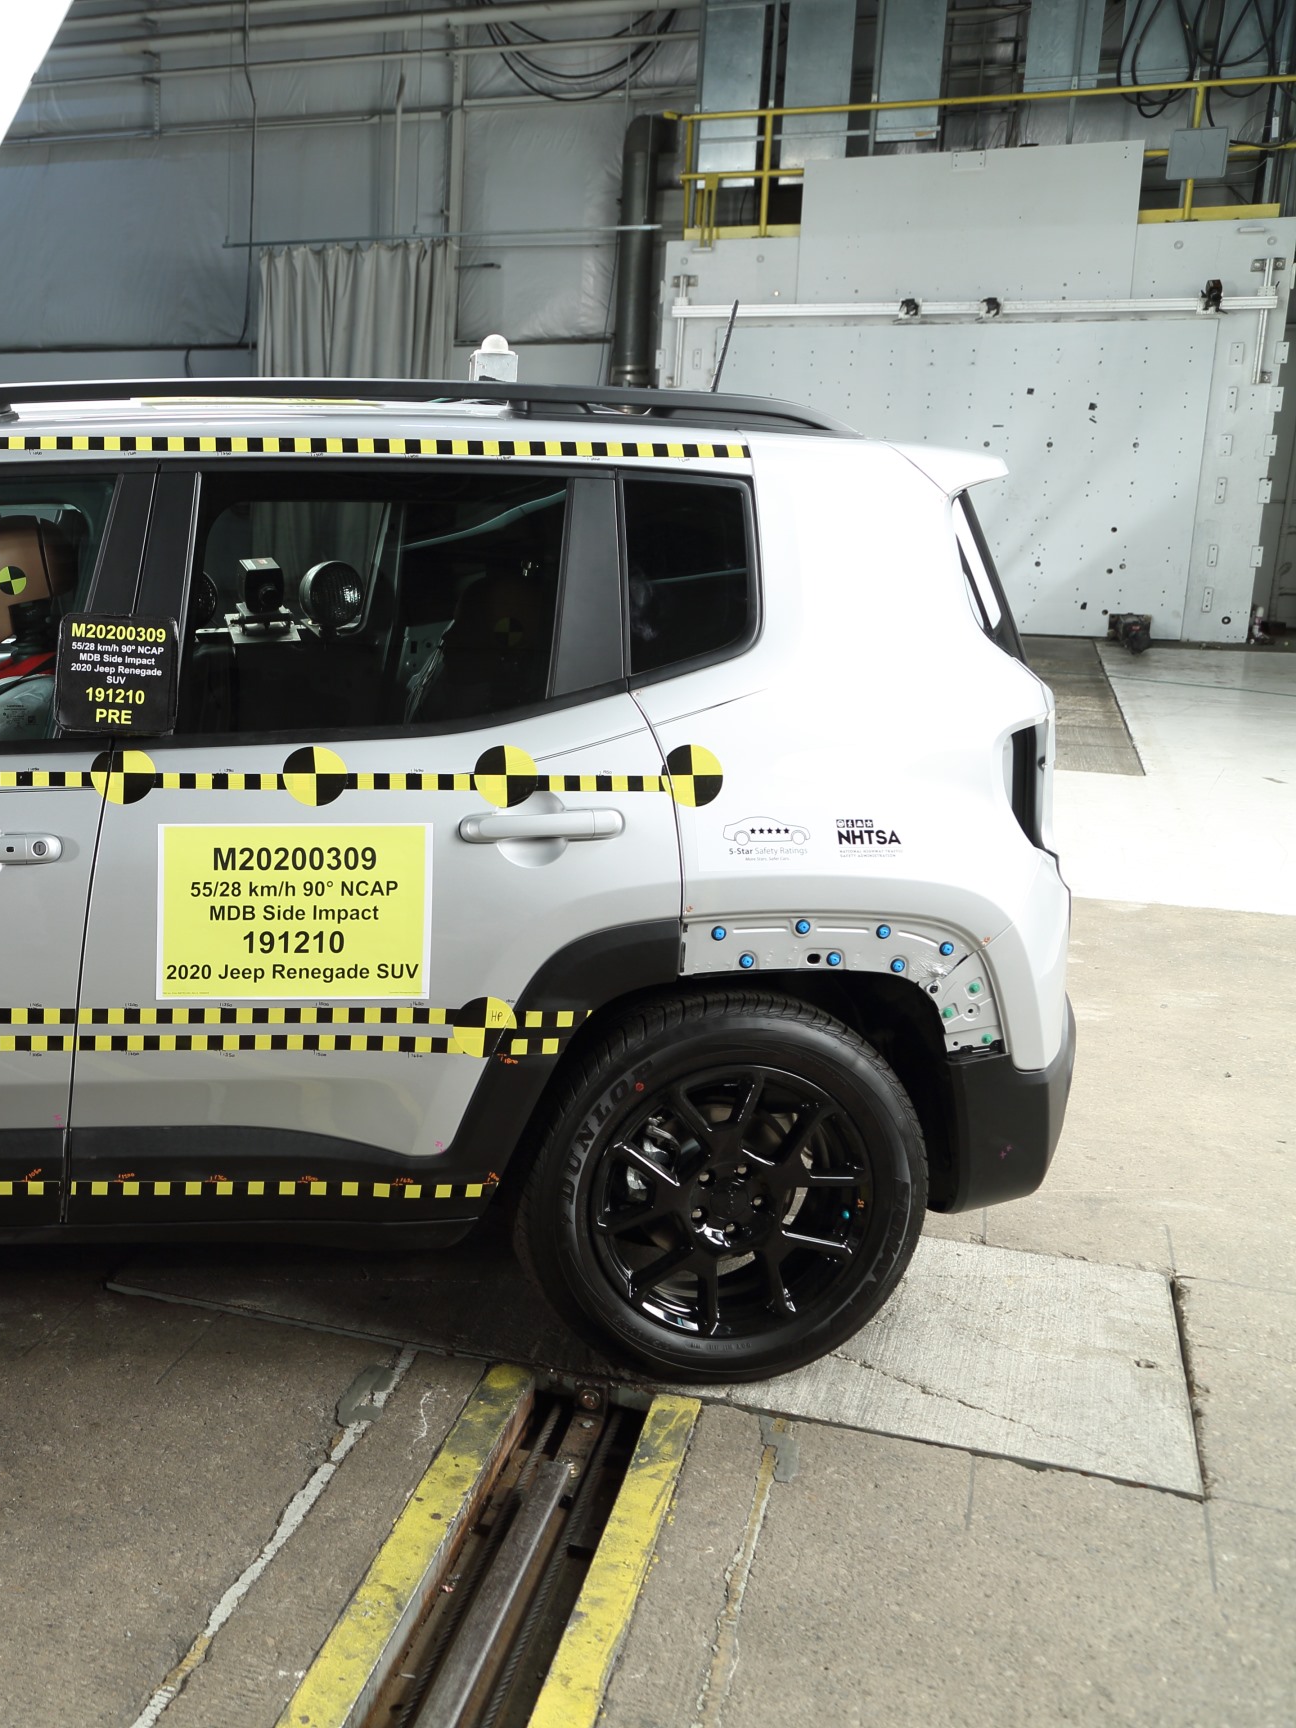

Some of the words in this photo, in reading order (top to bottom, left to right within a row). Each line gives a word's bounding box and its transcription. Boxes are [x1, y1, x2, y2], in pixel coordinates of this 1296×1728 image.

[71, 622, 167, 643] M20200309
[71, 642, 95, 651] 55/28
[97, 643, 119, 653] km/h
[137, 645, 164, 655] NCAP
[79, 652, 101, 662] MDB
[103, 654, 123, 663] Side
[125, 655, 155, 666] Impact
[70, 663, 92, 672] 2020
[94, 664, 116, 675] Jeep
[117, 665, 162, 677] Renegade
[106, 675, 126, 685] SUV
[85, 686, 145, 705] 191210
[95, 708, 132, 725] PRE
[837, 829, 902, 845] NHTSA
[213, 846, 377, 871] M20200309
[729, 847, 753, 855] 5-Star
[754, 847, 778, 856] Safety
[779, 847, 808, 856] Ratings
[190, 881, 241, 897] 55/28
[248, 881, 296, 897] km/h
[303, 880, 334, 897] 90°
[340, 880, 399, 897] NCAP
[209, 905, 255, 921] MDB
[262, 905, 306, 921] Side
[313, 904, 379, 924] Impact
[242, 930, 345, 954] 191210
[166, 964, 212, 980] 2020
[218, 964, 265, 983] Jeep
[272, 963, 370, 983] Renegade
[376, 963, 419, 979] SUV
[491, 1010, 503, 1022] HP
[560, 1059, 653, 1206] DUNLOP
